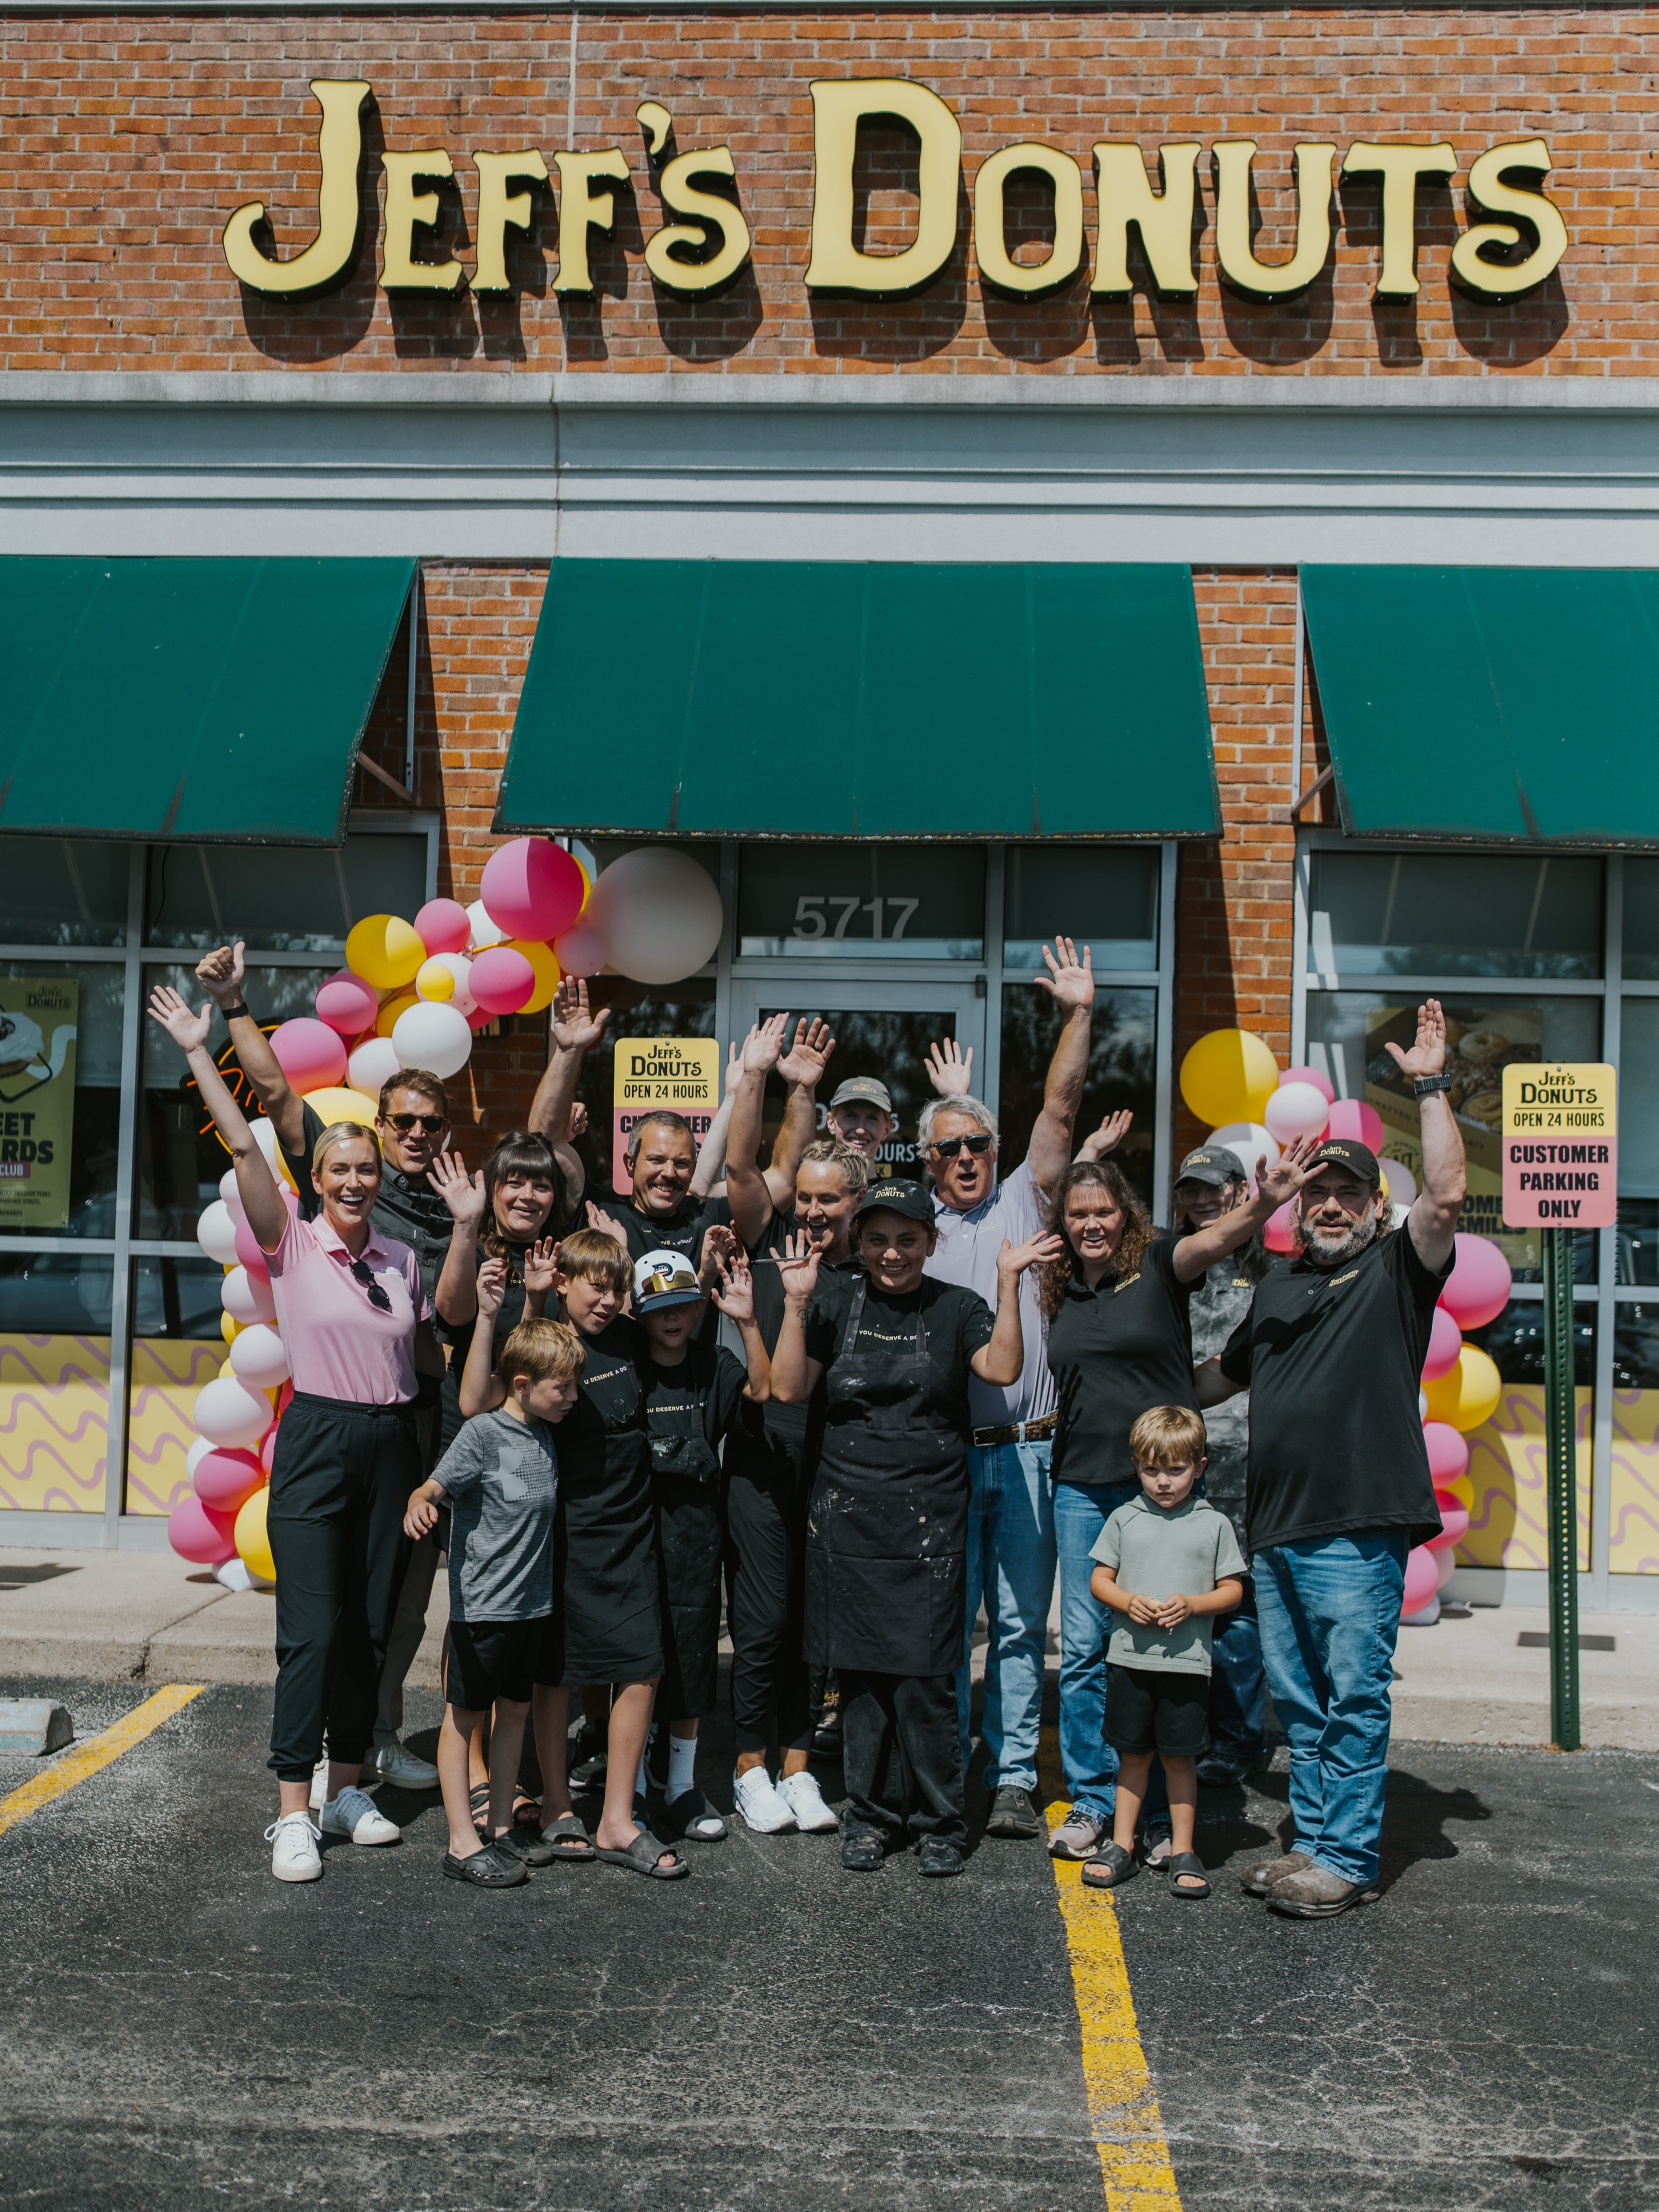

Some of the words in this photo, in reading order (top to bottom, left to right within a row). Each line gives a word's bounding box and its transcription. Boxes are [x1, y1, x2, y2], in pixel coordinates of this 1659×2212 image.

[224, 79, 751, 295] JEFF'S
[805, 78, 1568, 296] DONUTS
[793, 896, 919, 941] 5717
[28, 993, 70, 1008] DONUTS
[648, 1045, 682, 1058] JEFF'S
[631, 1056, 702, 1076] DONUTS
[1539, 1071, 1575, 1085] JEFF'S
[624, 1084, 650, 1098] OPEN
[655, 1084, 668, 1098] 24
[673, 1084, 708, 1098] HOURS
[1521, 1083, 1597, 1104] DONUTS
[1514, 1112, 1542, 1127] OPEN
[1548, 1112, 1561, 1127] 24
[1567, 1112, 1604, 1127] HOURS
[1510, 1145, 1609, 1163] CUSTOMER
[1520, 1172, 1599, 1191] PARKING
[874, 1190, 905, 1198] DONUTS
[1538, 1200, 1581, 1218] ONLY
[873, 1332, 902, 1341] DESERVE
[590, 1371, 615, 1382] DESERVE
